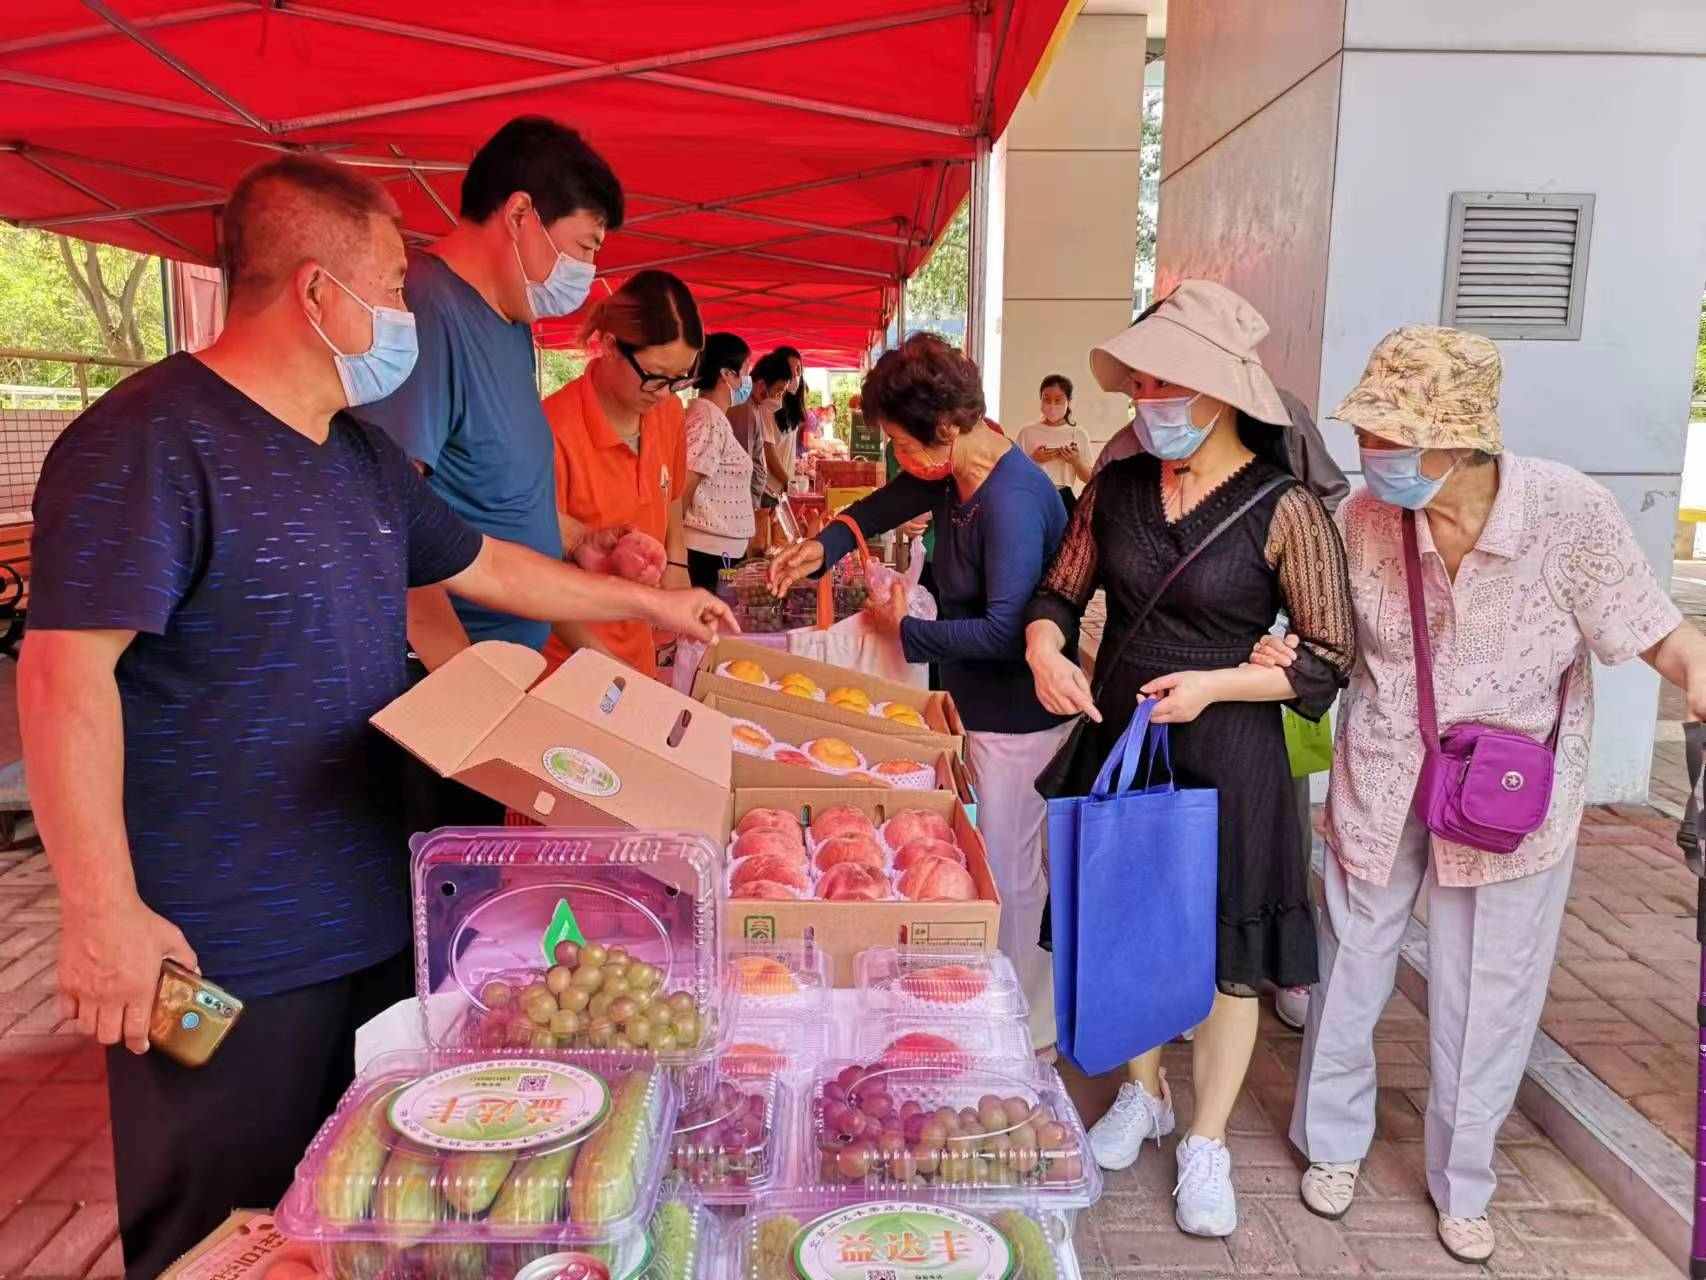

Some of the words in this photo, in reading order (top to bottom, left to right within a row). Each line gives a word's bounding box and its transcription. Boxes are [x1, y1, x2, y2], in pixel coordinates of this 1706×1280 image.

[425, 1097, 567, 1124] 益达丰
[836, 1230, 973, 1263] 益达丰
